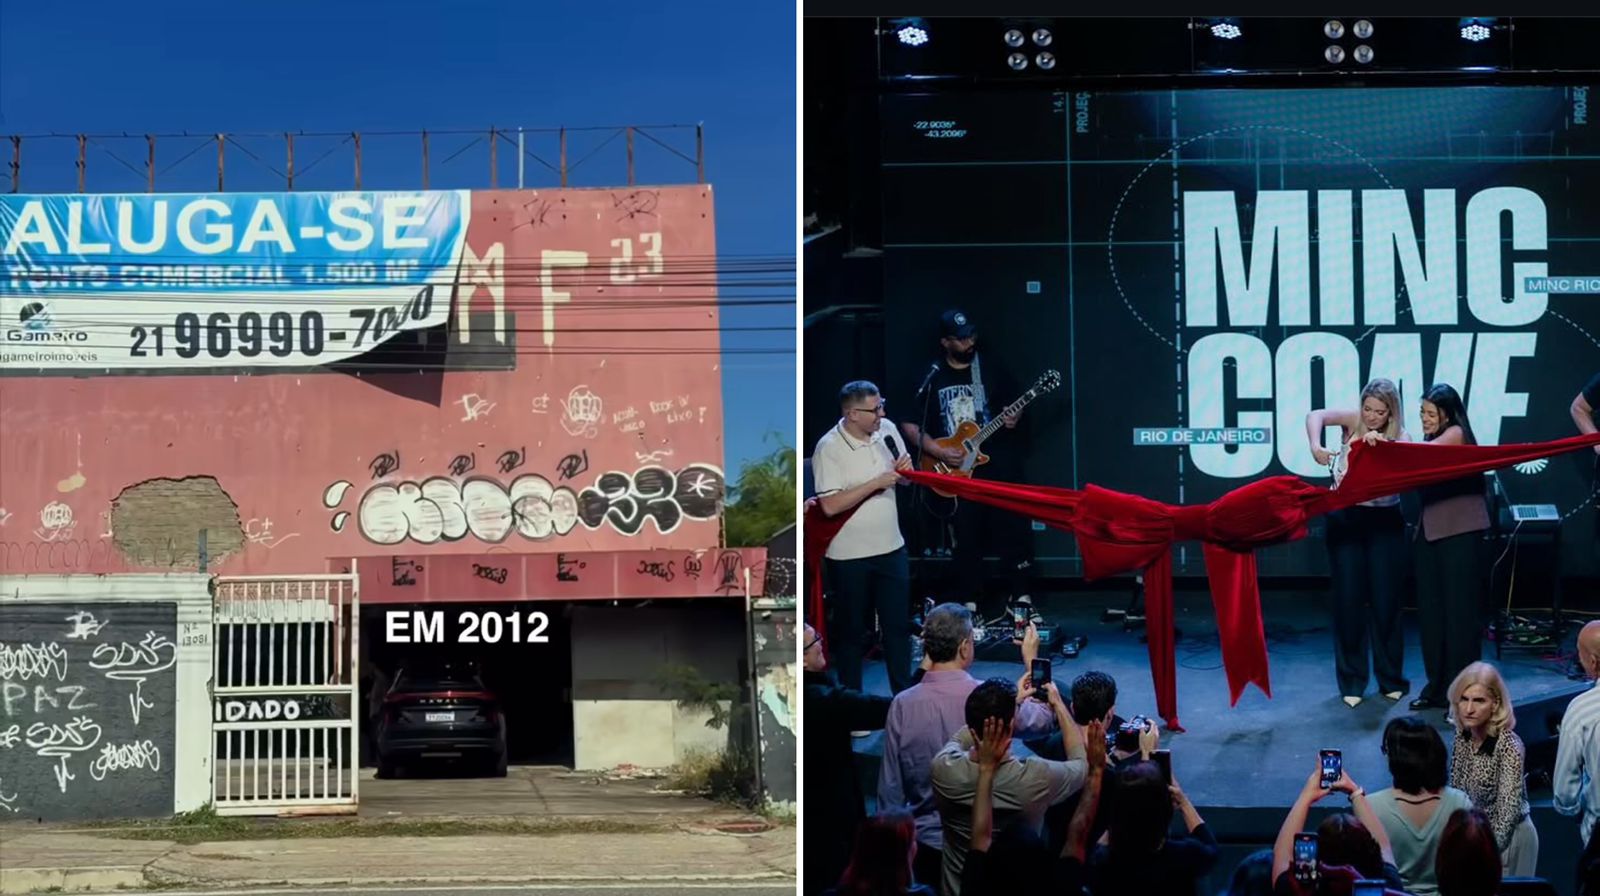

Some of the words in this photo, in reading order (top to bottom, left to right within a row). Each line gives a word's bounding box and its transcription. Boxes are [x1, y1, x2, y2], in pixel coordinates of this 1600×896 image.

[5, 199, 429, 255] ALUGA-SE
[1184, 186, 1548, 327] MINC
[119, 264, 291, 287] COMERCIAL
[1528, 279, 1570, 291] MINC
[0, 350, 97, 363] gameiroimoveis
[1140, 431, 1168, 442] RIO
[1172, 431, 1193, 442] DE
[1197, 431, 1265, 442] JANEIRO
[3, 681, 97, 717] PAZ
